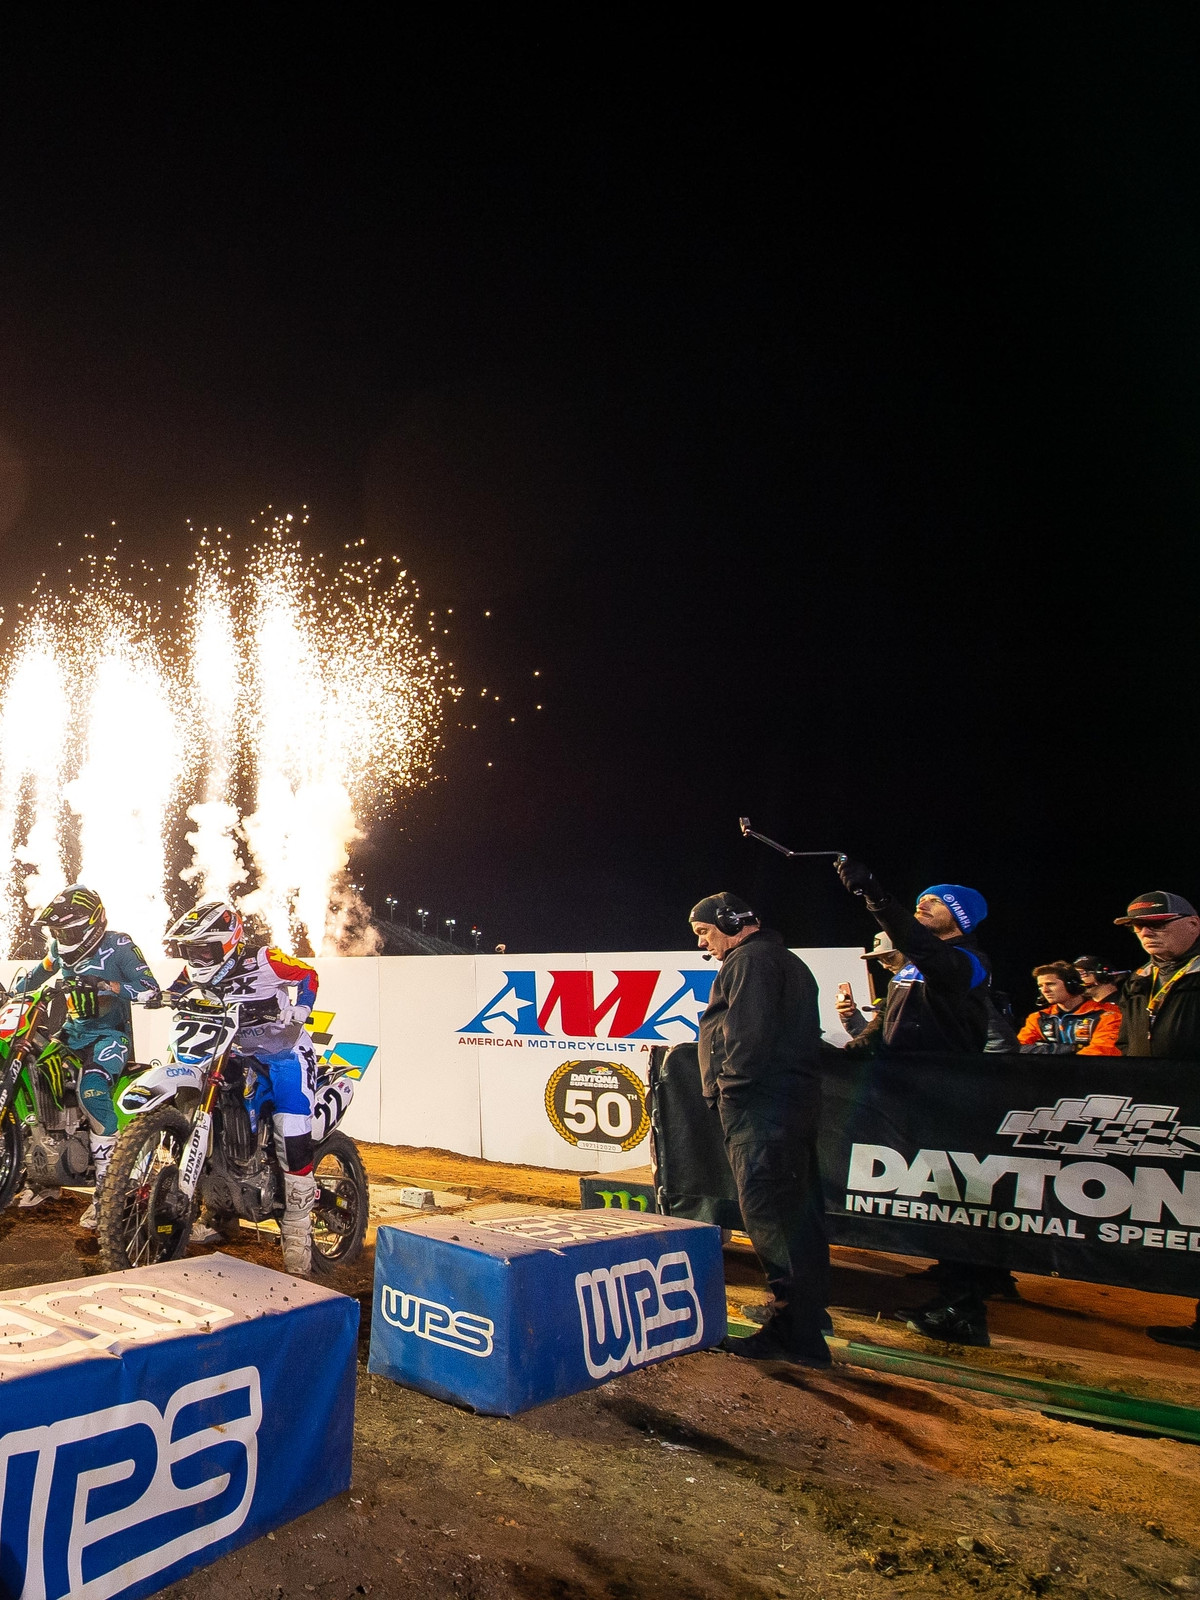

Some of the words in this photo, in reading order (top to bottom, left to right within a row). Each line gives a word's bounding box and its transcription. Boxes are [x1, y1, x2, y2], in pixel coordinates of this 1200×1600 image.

[950, 901, 971, 929] YAMAHA
[454, 970, 718, 1041] AMA
[175, 1021, 229, 1059] 22
[458, 1036, 523, 1048] AMERICAN
[527, 1039, 636, 1052] MOTORCYCLIST
[569, 1080, 619, 1089] SUPERCROSS
[570, 1073, 619, 1084] DAYTONA
[314, 1088, 347, 1141] 22
[563, 1089, 633, 1138] 50
[626, 1093, 638, 1101] TH
[183, 1129, 201, 1185] DUNLOP
[846, 1143, 1200, 1227] DAYTON
[845, 1194, 1086, 1239] INTERNATIONAL
[381, 1284, 494, 1358] WPS
[575, 1250, 704, 1379] WPS
